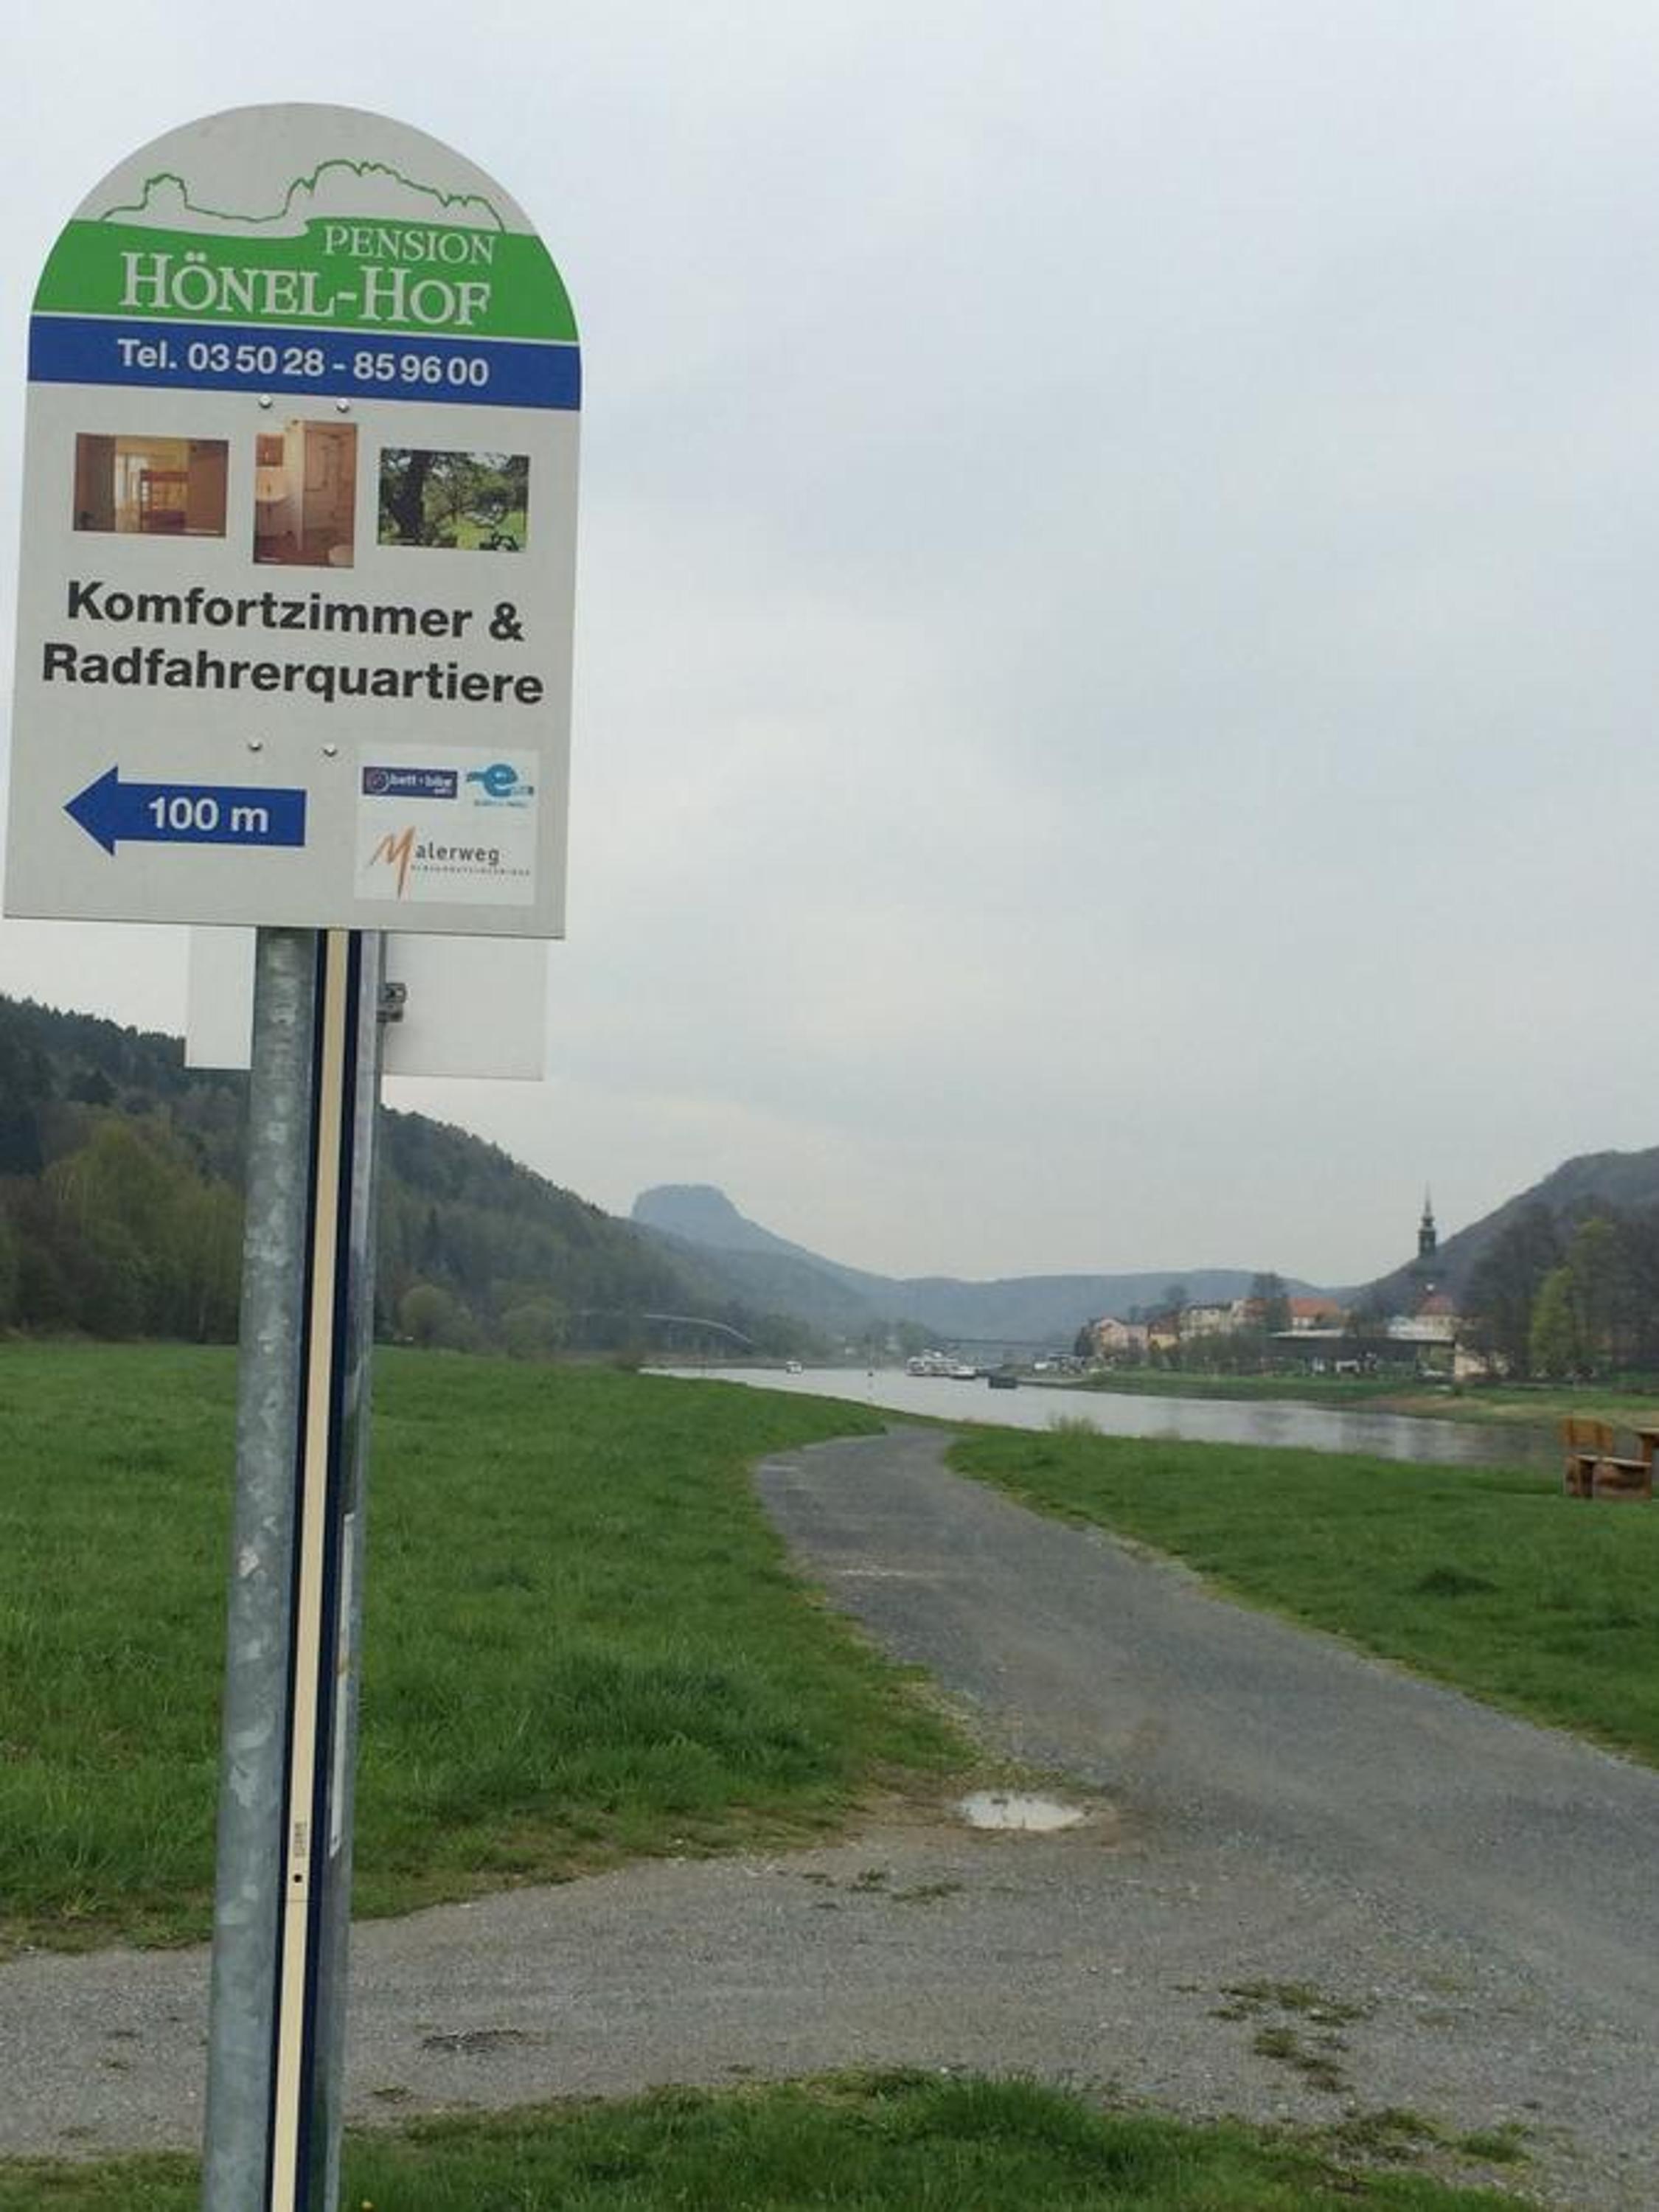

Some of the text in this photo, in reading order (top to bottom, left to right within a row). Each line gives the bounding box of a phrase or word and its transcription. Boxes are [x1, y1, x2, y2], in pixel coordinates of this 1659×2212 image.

[324, 224, 496, 265] PENSION
[117, 338, 177, 369] Tel.
[68, 580, 524, 642] Komfortzimmer &
[43, 642, 543, 705] Radfahrerquartiere
[148, 796, 268, 832] 100 m
